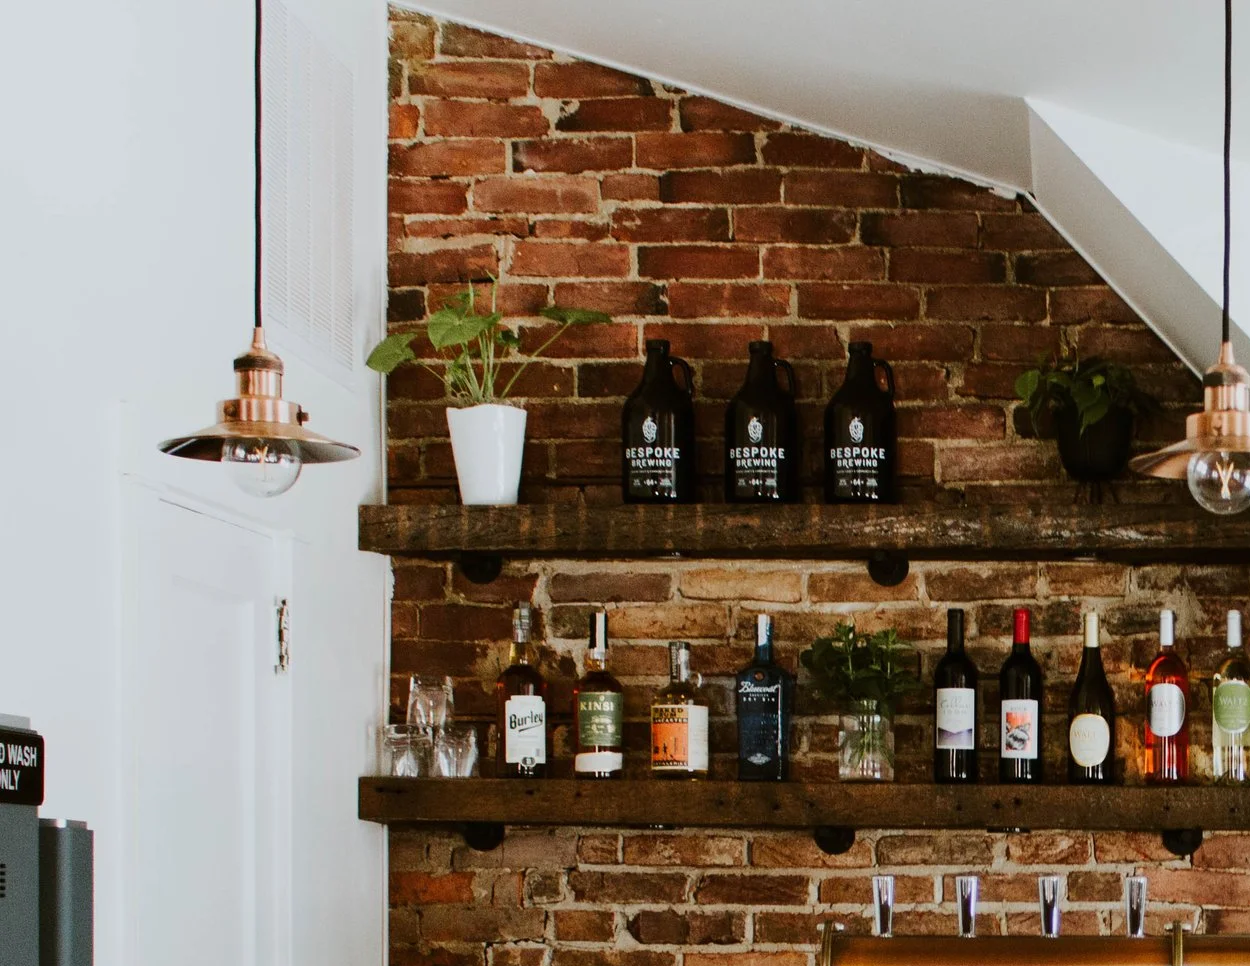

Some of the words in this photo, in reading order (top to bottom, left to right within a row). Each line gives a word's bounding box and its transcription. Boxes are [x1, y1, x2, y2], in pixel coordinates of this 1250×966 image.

[626, 447, 680, 459] BESPOKE
[730, 447, 785, 459] BESPOKE
[830, 447, 886, 459] BESPOKE
[631, 459, 672, 468] BREWING
[736, 459, 777, 468] BREWING
[837, 459, 878, 468] BREWING
[509, 710, 544, 730] Burley
[8, 743, 37, 767] WASH
[0, 768, 20, 790] NLY
